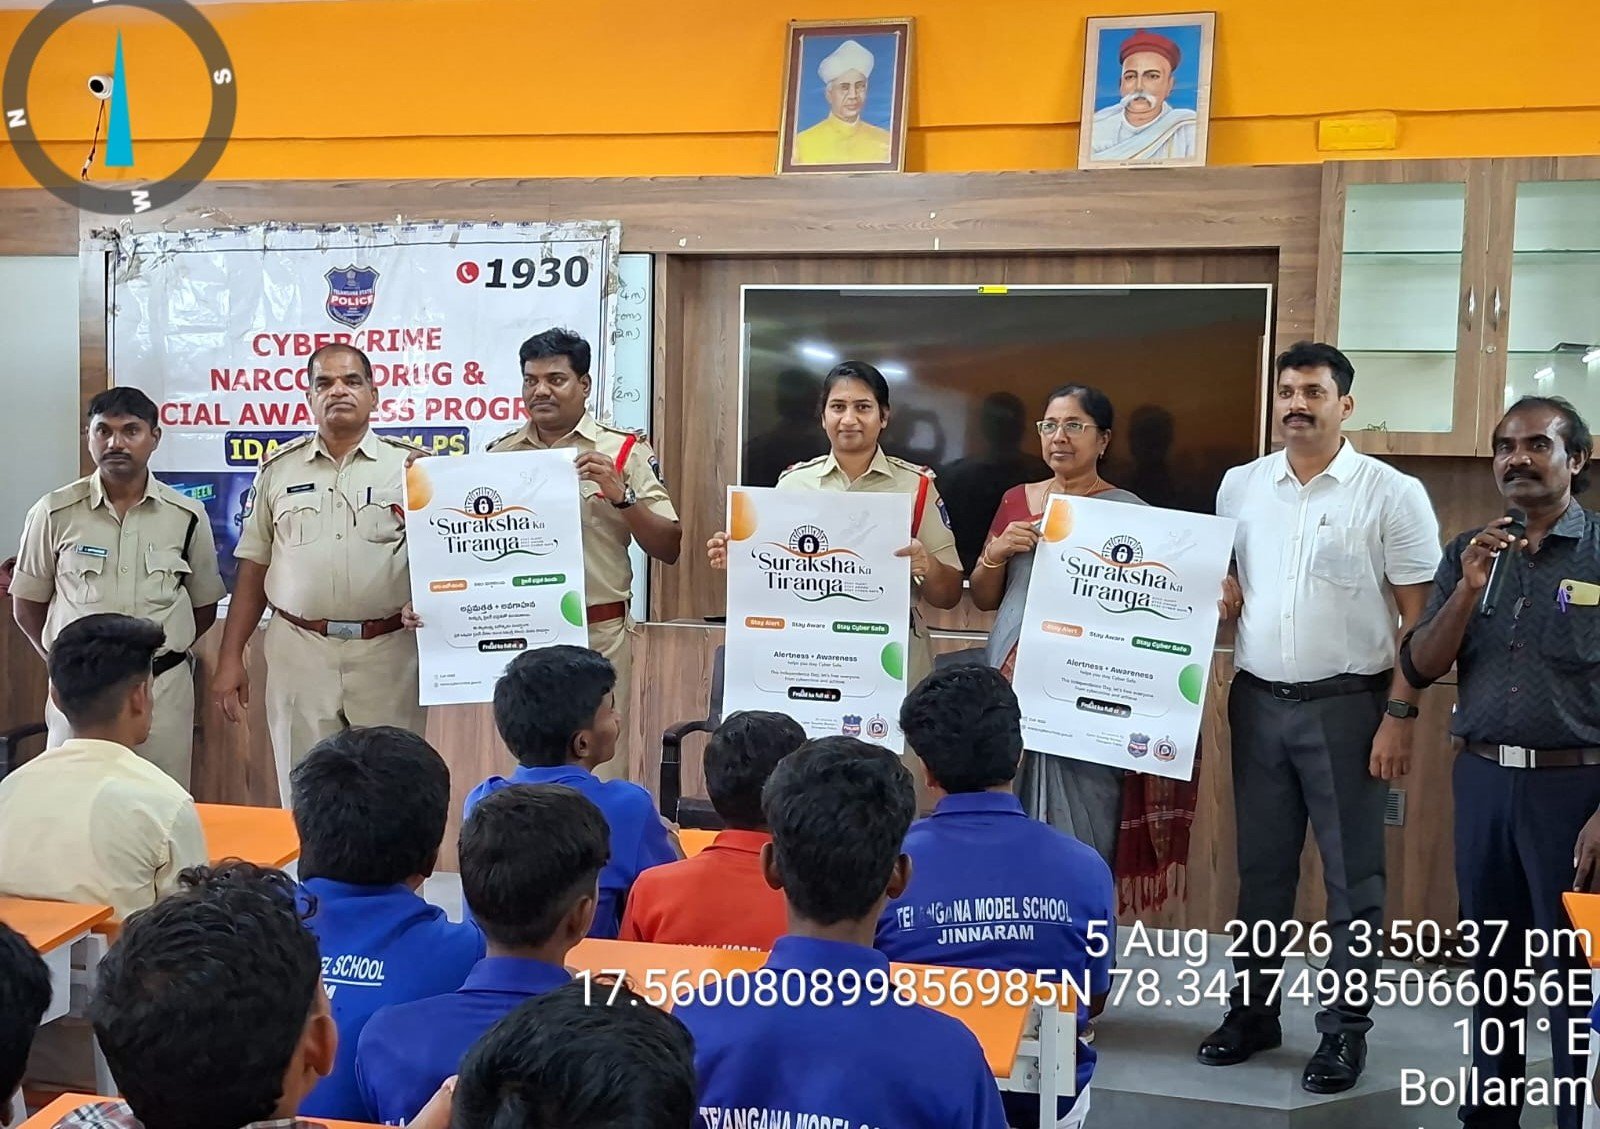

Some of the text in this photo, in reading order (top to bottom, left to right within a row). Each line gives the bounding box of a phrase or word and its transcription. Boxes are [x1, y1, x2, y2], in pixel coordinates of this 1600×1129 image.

[485, 256, 589, 289] 1930
[331, 294, 374, 306] POLICE
[210, 361, 486, 391] NARCO DRUG &
[160, 403, 231, 426] CIAL
[425, 397, 532, 421] PROGR
[444, 536, 519, 556] Tiranga
[859, 565, 872, 575] Ka
[764, 572, 843, 595] Tiranga
[1071, 576, 1150, 609] Tiranga
[1169, 581, 1183, 593] Ka
[836, 623, 851, 631] Stay
[852, 624, 870, 632] Cyber
[1089, 631, 1104, 639] Stay
[1136, 639, 1151, 647] Stay
[1152, 641, 1171, 649] Cyber
[773, 651, 810, 660] Alertness
[816, 653, 858, 662] Awareness
[1066, 659, 1103, 671] Alertness
[1110, 667, 1154, 680] Awareness
[974, 896, 1019, 922] MODEL
[1023, 896, 1073, 923] SCHOOL
[937, 924, 1034, 945] JINNARAM
[332, 954, 385, 980] SCHOOL
